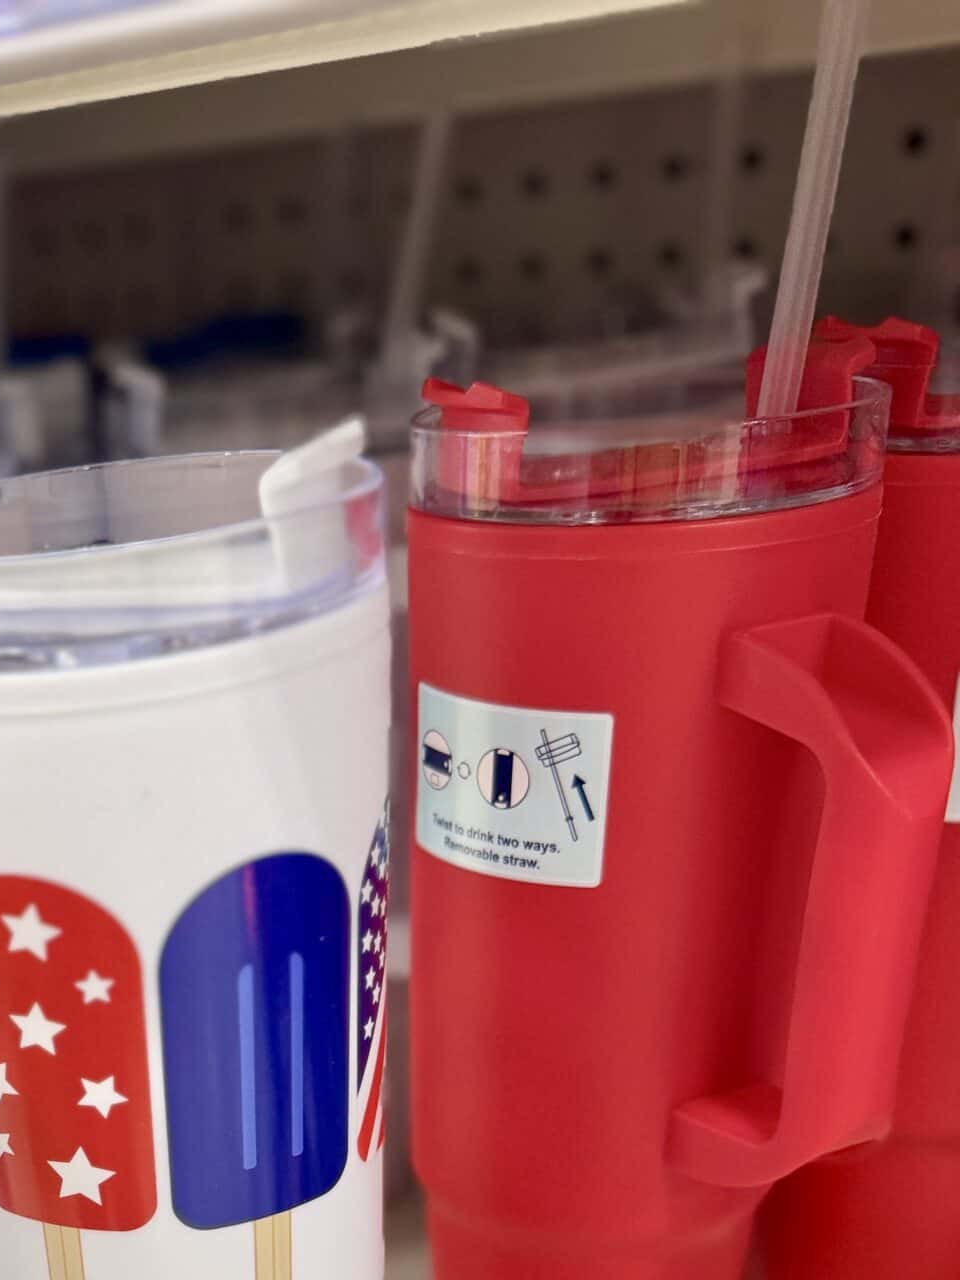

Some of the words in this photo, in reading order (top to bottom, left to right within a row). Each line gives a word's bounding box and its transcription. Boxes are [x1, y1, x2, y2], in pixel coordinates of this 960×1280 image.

[432, 813, 453, 831] Twist
[454, 820, 465, 836] to
[466, 825, 494, 843] drink
[497, 834, 520, 849] two
[522, 838, 561, 855] ways.
[444, 836, 499, 863] Removable
[502, 851, 541, 870] straw.
